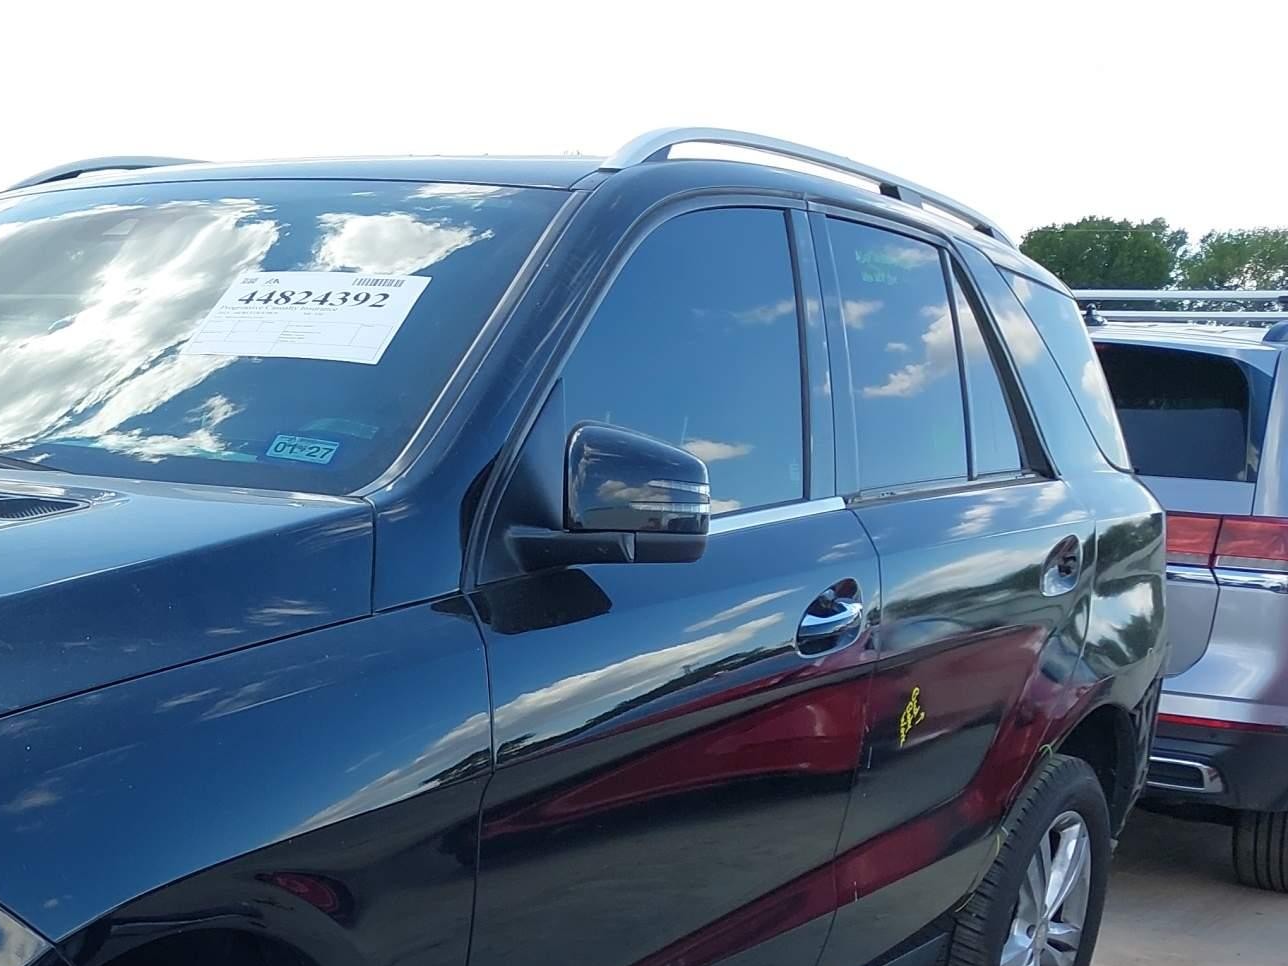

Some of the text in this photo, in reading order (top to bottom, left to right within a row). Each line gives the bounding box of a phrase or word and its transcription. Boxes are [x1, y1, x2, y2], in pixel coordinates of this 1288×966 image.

[238, 290, 390, 308] 44824392
[274, 441, 297, 454] 01
[305, 446, 334, 458] 27
